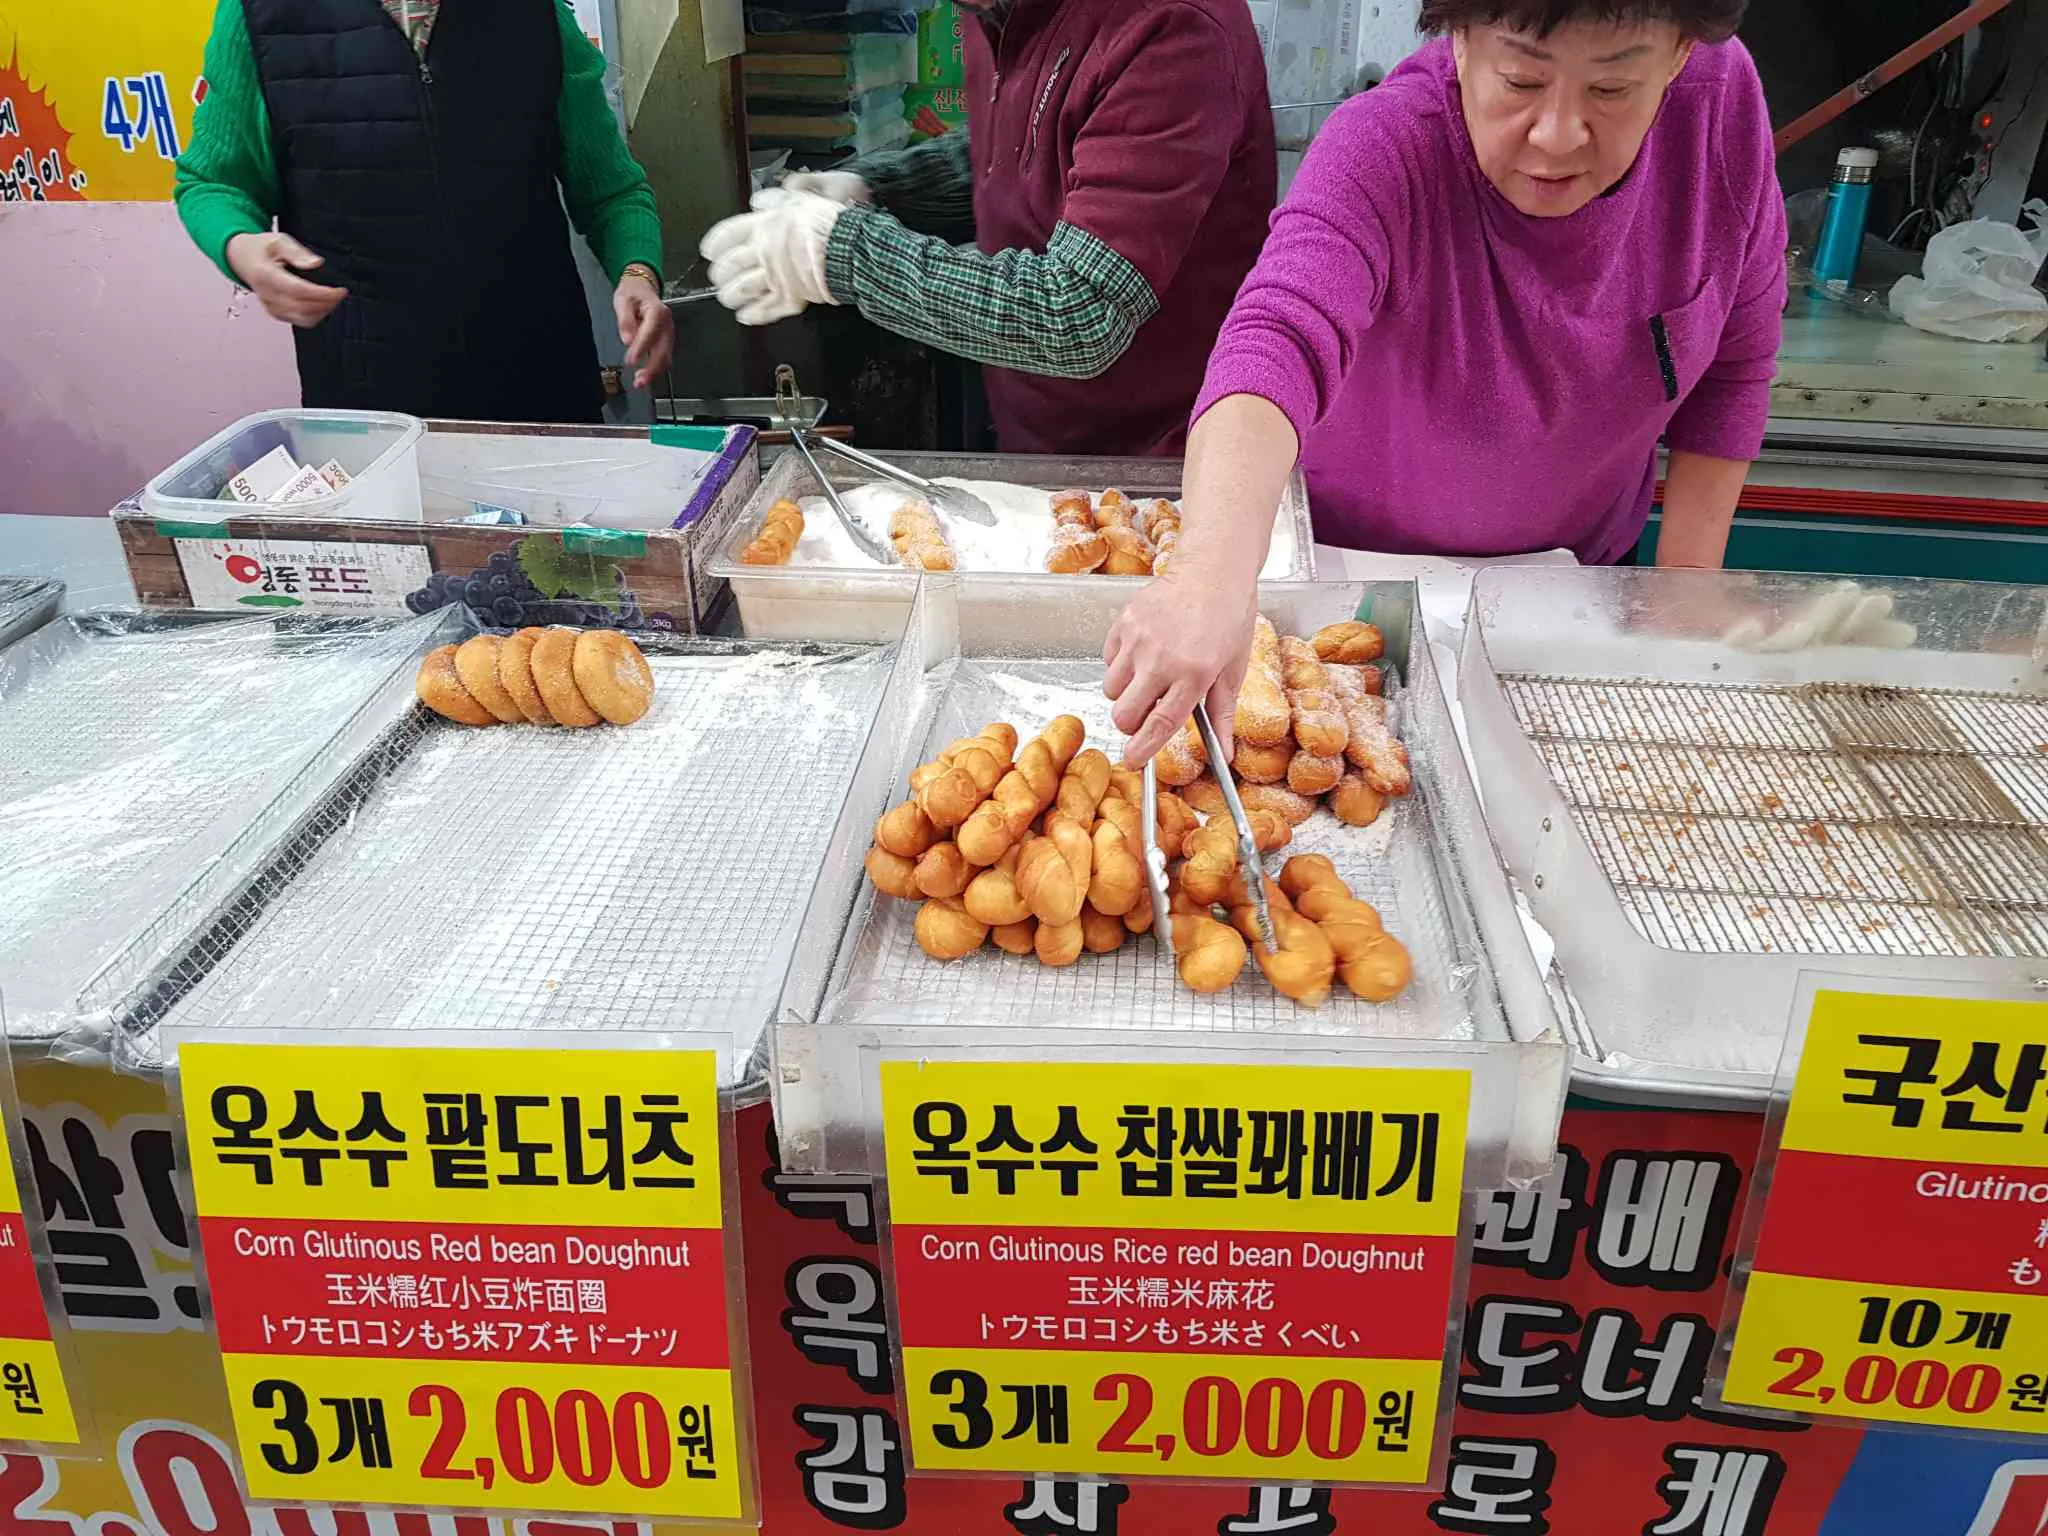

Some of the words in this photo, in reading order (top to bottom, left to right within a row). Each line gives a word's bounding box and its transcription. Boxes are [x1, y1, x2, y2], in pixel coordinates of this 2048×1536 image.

[103, 73, 181, 161] 4개
[305, 566, 373, 594] 포도
[1842, 1034, 2048, 1134] 국산
[211, 1086, 408, 1188] 옥수수
[423, 1092, 695, 1190] 팥도너츠
[912, 1101, 1099, 1196] 옥수수
[1114, 1105, 1440, 1203] 찹쌀꽈배기
[1915, 1171, 2048, 1203] Glutino
[234, 1228, 295, 1257] Corn
[303, 1230, 422, 1261] Glutinous
[430, 1233, 481, 1262] Red
[491, 1235, 556, 1264] bean
[565, 1237, 690, 1270] Doughnut
[921, 1234, 980, 1260] Corn
[989, 1235, 1104, 1263] Glutinous
[1114, 1238, 1168, 1264] Rice
[1177, 1241, 1219, 1265] red
[1229, 1241, 1292, 1267] bean
[1302, 1243, 1425, 1273] Doughnut
[324, 1273, 607, 1314] 玉米糯红小豆炸面圈
[1067, 1275, 1276, 1311] 玉米糯米麻花
[1857, 1296, 2012, 1350] 10개
[1461, 1302, 1703, 1406] 도너
[2, 1362, 44, 1415] 원
[929, 1369, 1070, 1450] 3개
[1093, 1373, 1415, 1461] 2,000원
[253, 1379, 393, 1475] 3개
[408, 1384, 718, 1490] 2,000원
